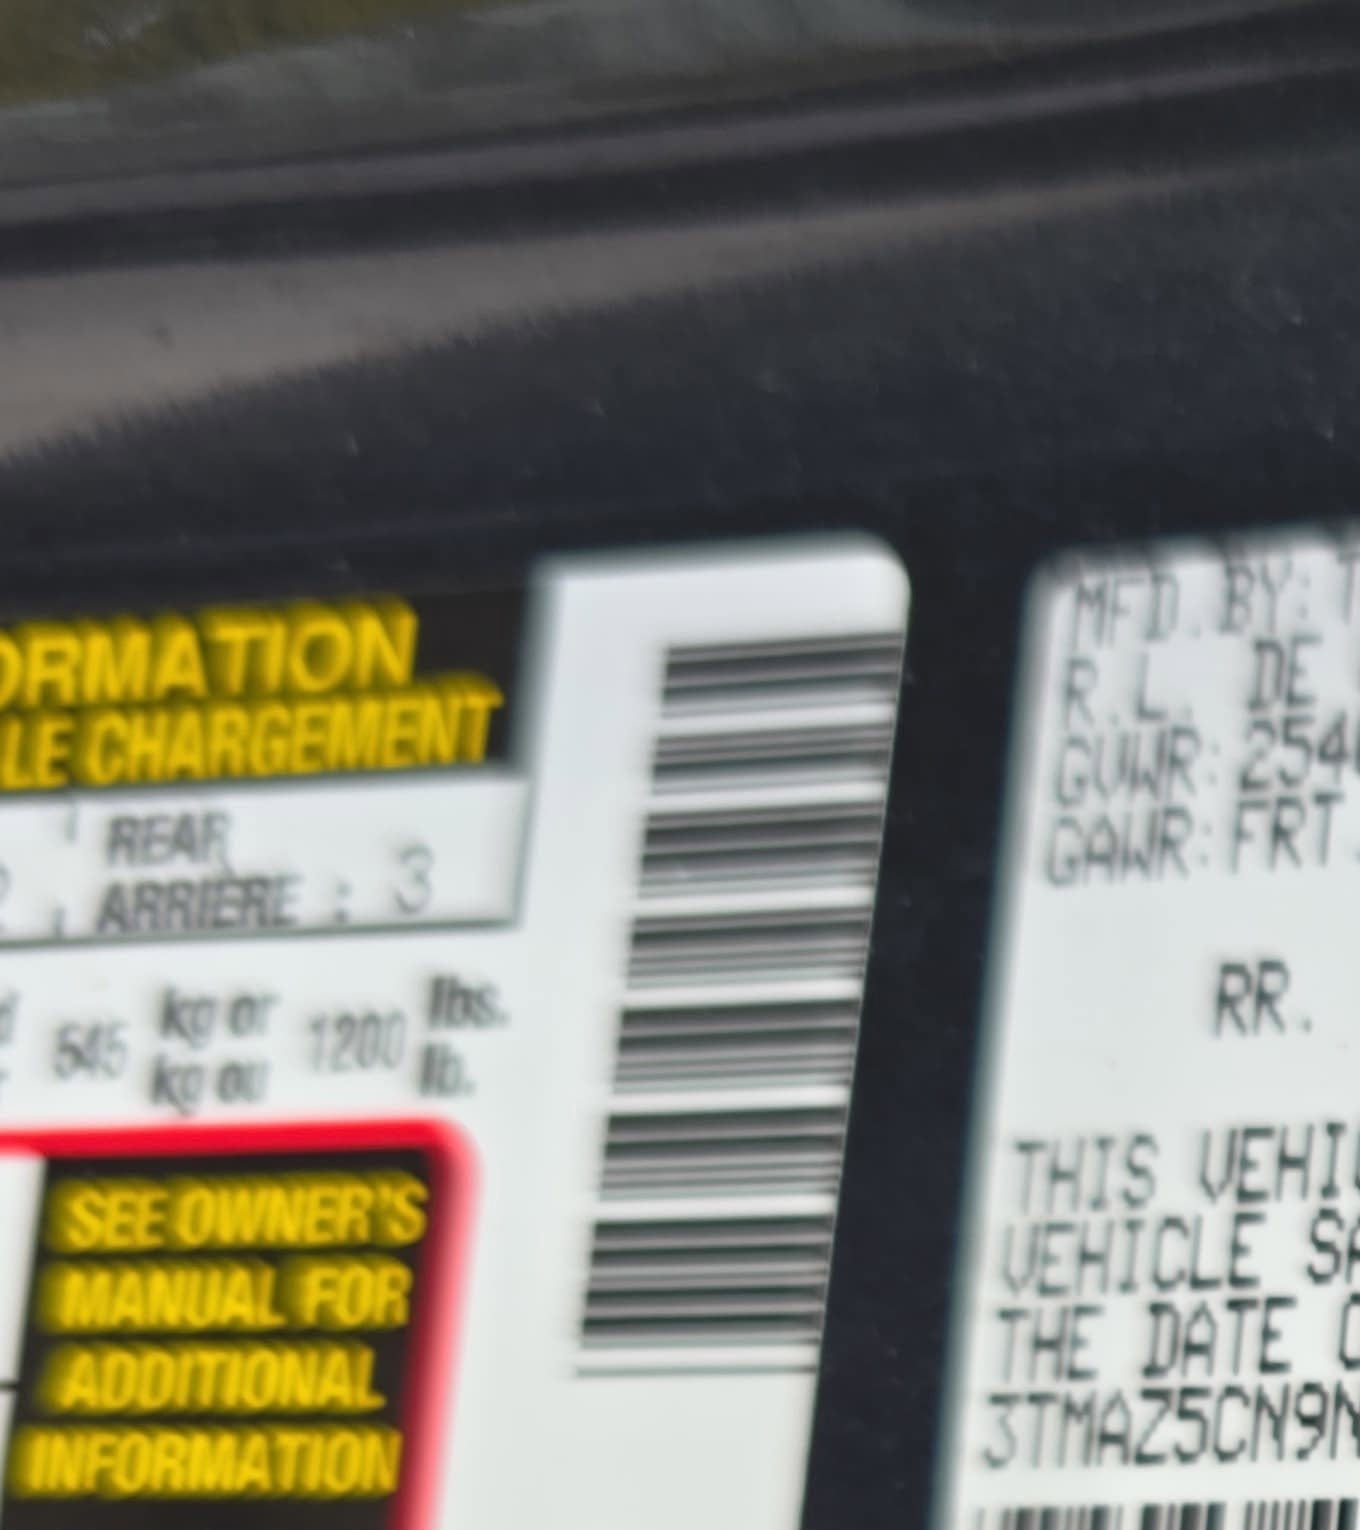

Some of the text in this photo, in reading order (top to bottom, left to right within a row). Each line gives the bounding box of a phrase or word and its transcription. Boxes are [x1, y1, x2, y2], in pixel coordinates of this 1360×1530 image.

[1249, 635, 1321, 714] DE
[83, 680, 503, 785] CHARGEMENT
[105, 808, 232, 868] REAR
[393, 843, 435, 918] 3
[158, 988, 215, 1048] kg
[227, 992, 277, 1040] or
[305, 1005, 407, 1070] 1200
[428, 973, 508, 1032] lbs.
[1214, 960, 1312, 1036] RR.
[148, 1055, 202, 1116] kg
[58, 1170, 430, 1252] SEE OWNER'S
[1014, 1133, 1158, 1213] THIS
[52, 1254, 415, 1332] MANUAL FOR
[1000, 1212, 1266, 1298] VEHICLE
[52, 1341, 388, 1415] ADDITIONAL
[999, 1303, 1102, 1384] THE
[1142, 1296, 1297, 1382] DATE
[20, 1424, 402, 1498] INFORMATION
